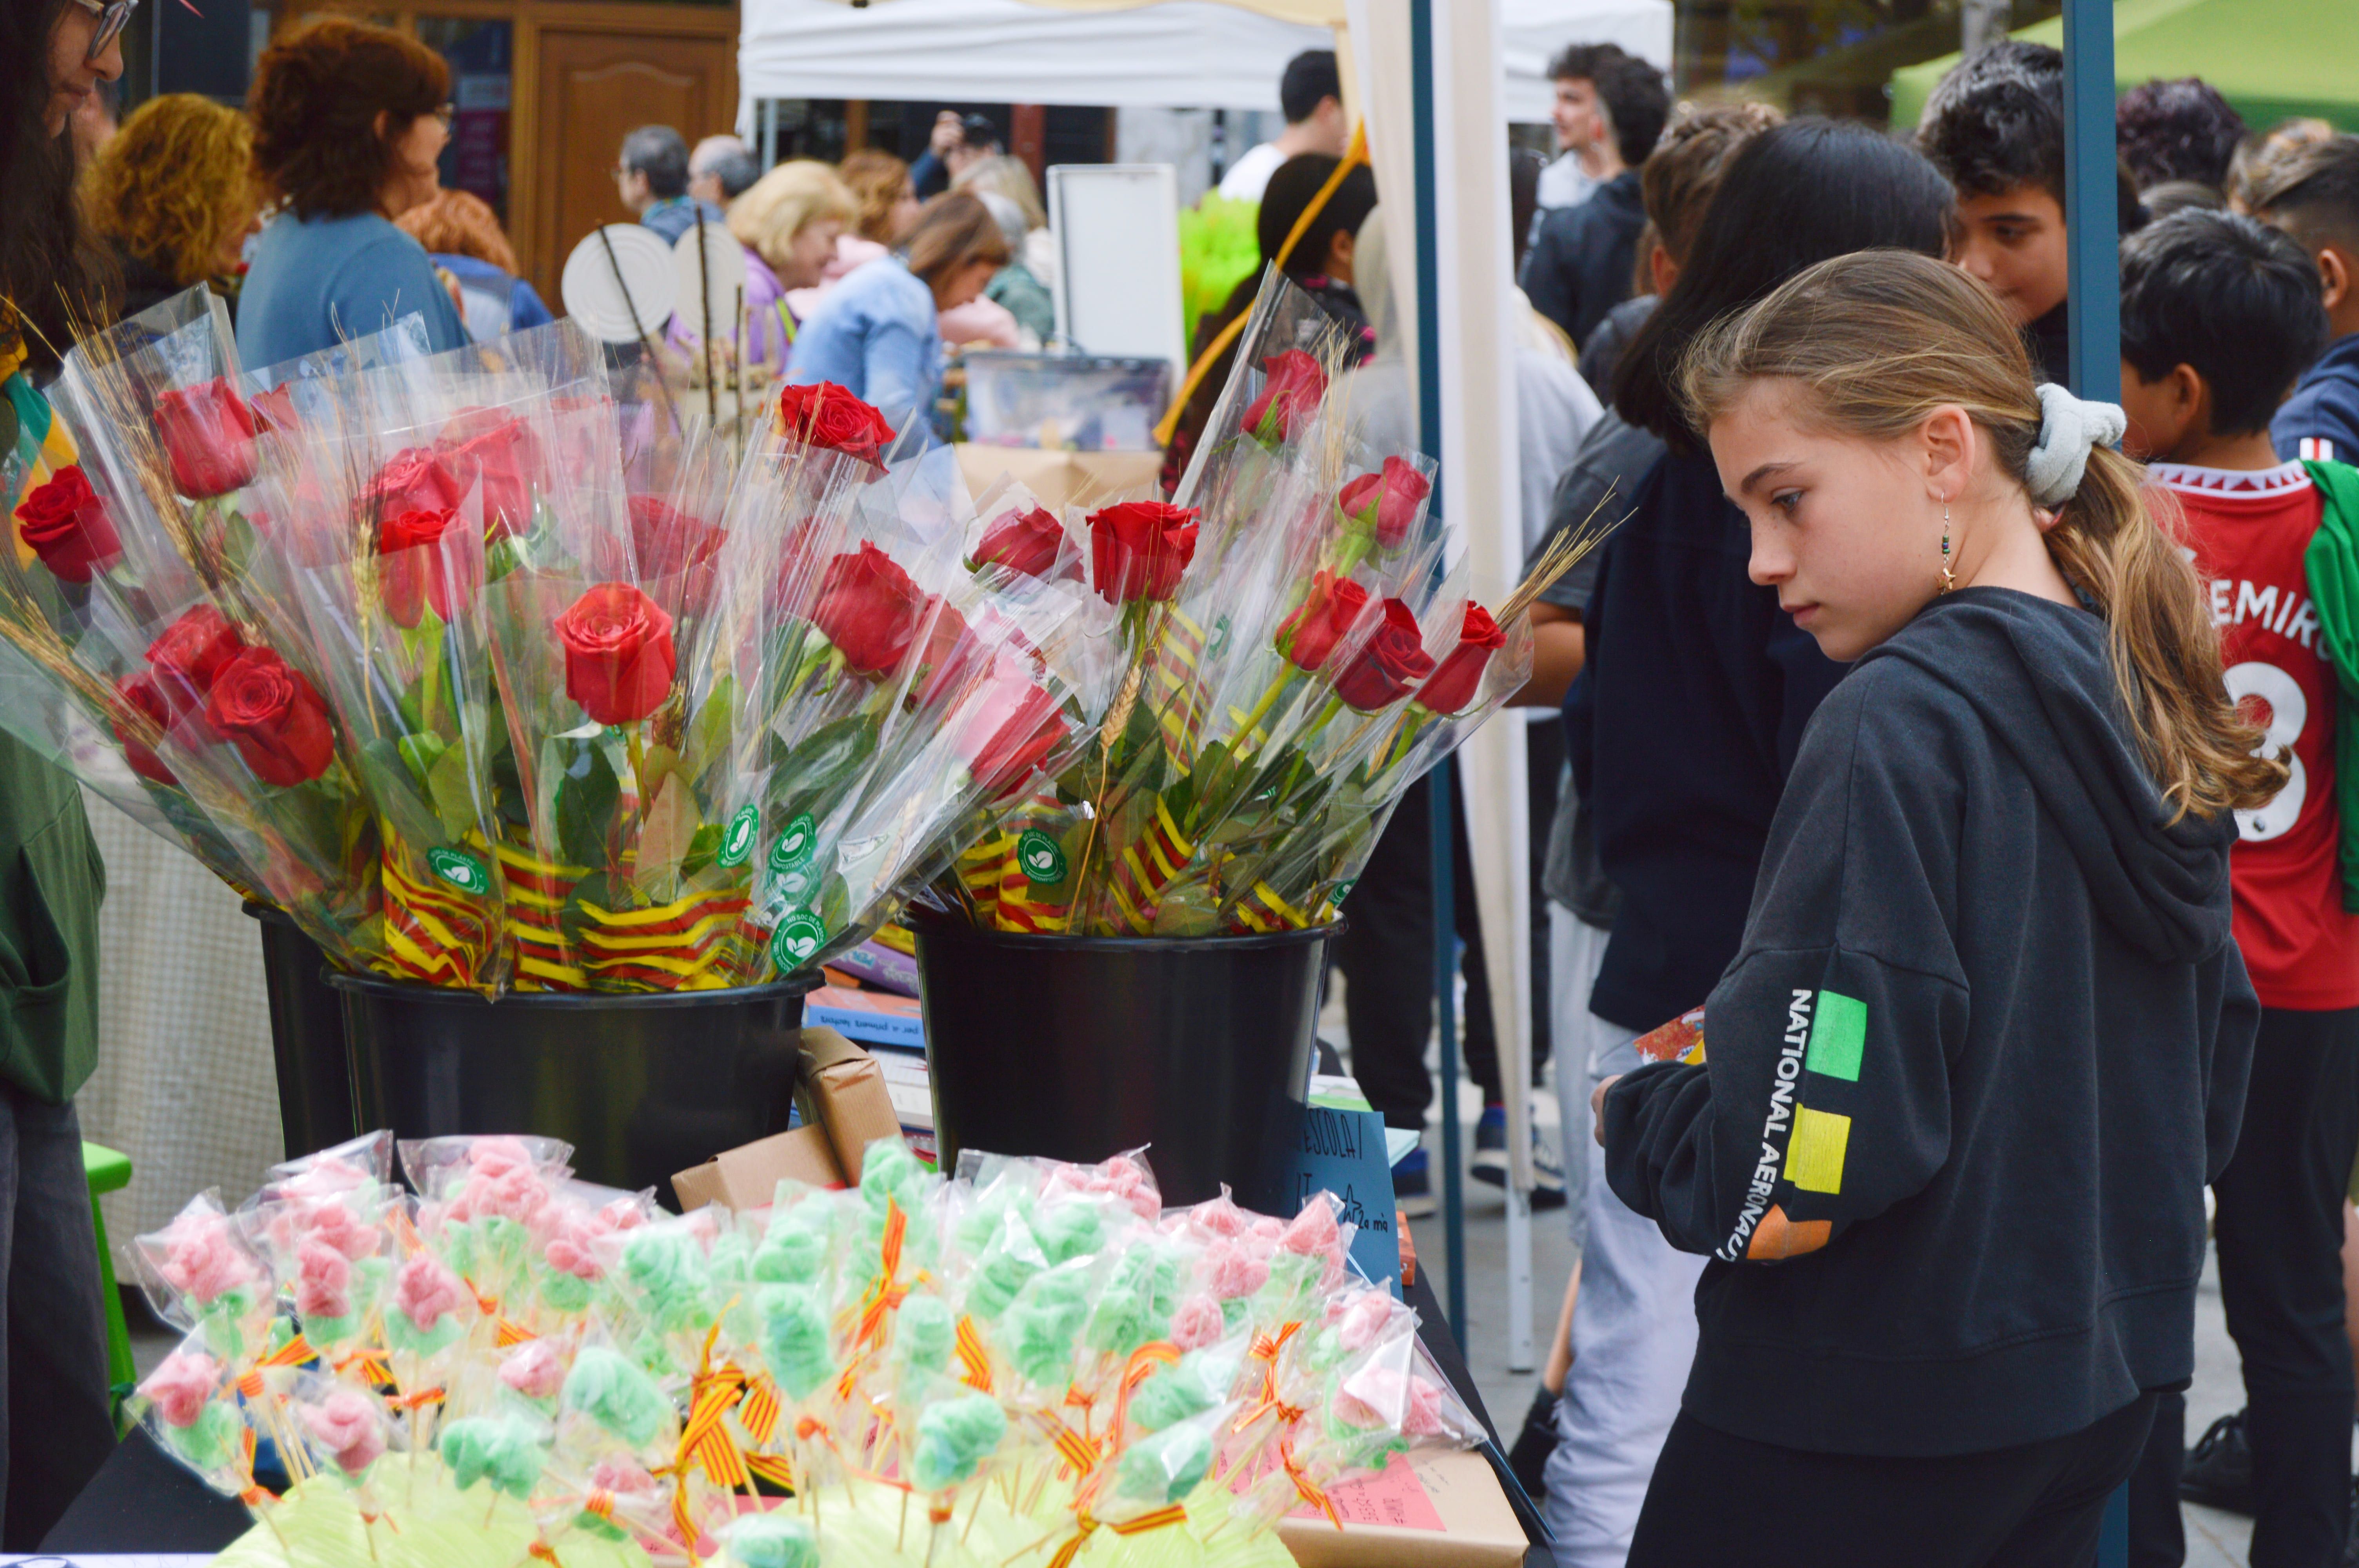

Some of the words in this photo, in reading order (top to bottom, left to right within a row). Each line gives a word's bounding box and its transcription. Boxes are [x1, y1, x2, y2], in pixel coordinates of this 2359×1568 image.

[2204, 579, 2332, 662] EMIR
[787, 915, 796, 924] NO
[809, 915, 816, 924] DE
[902, 1026, 919, 1034] per
[1764, 989, 1812, 1138] NATIONAL
